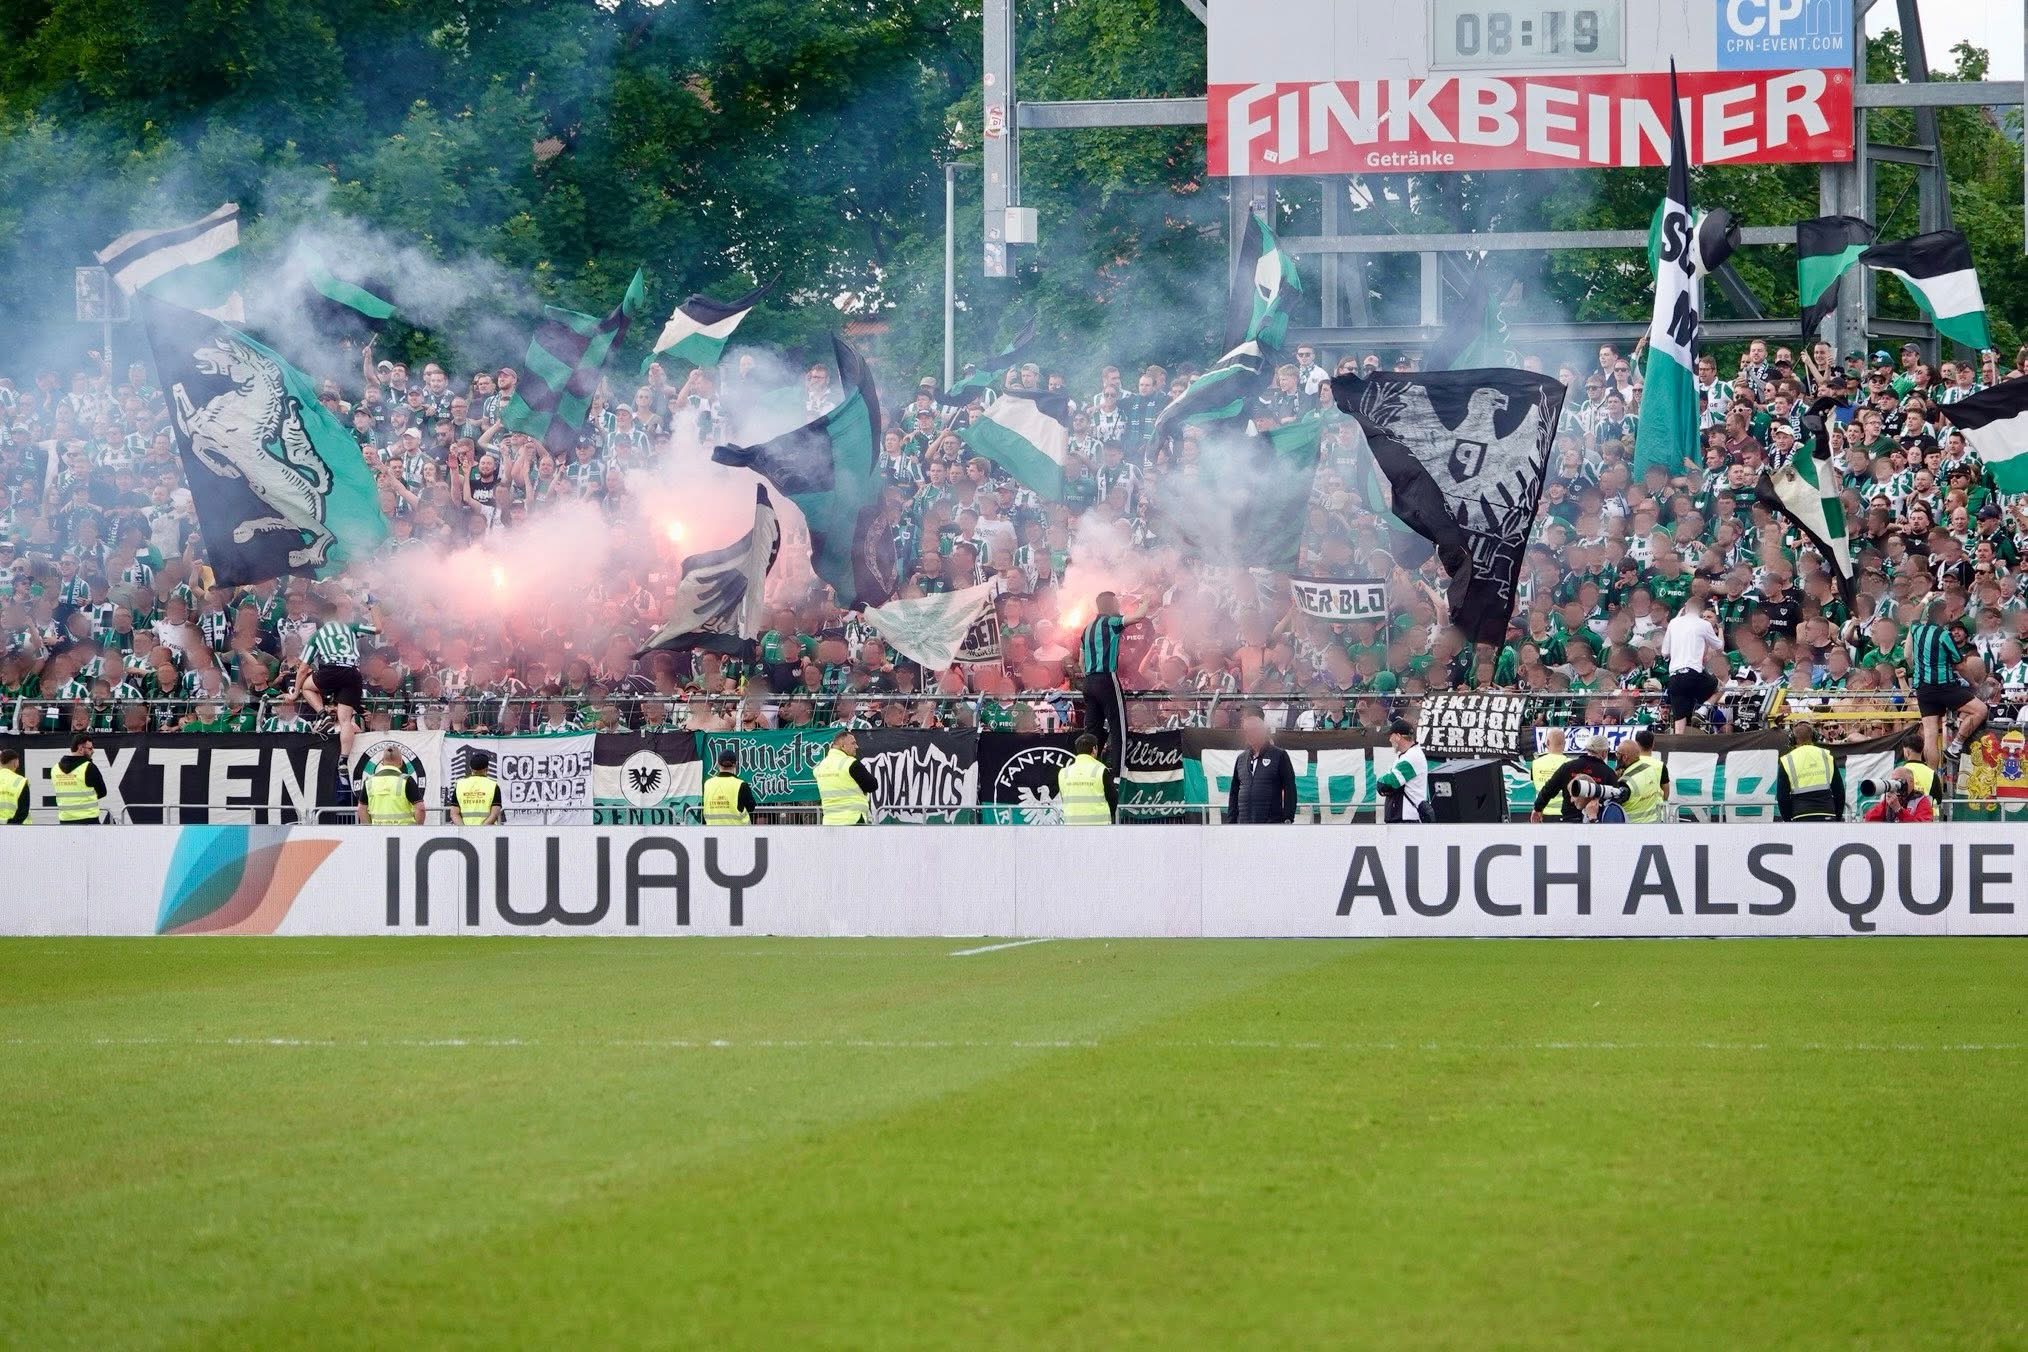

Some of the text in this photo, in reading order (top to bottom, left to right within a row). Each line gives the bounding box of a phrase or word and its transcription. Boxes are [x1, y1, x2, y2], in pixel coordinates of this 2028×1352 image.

[1727, 37, 1843, 52] CPN-EVENT.COM
[1228, 69, 1831, 176] FINKBEINER
[1366, 150, 1455, 167] Getränke
[1421, 695, 1527, 714] SEKTION
[1417, 709, 1522, 731] STADION
[1415, 726, 1519, 750] VERBOT
[502, 751, 592, 780] COERDE
[511, 778, 586, 803] BANDE
[386, 836, 768, 926] INWAY
[1336, 842, 2015, 931] AUCH ALS QUE
